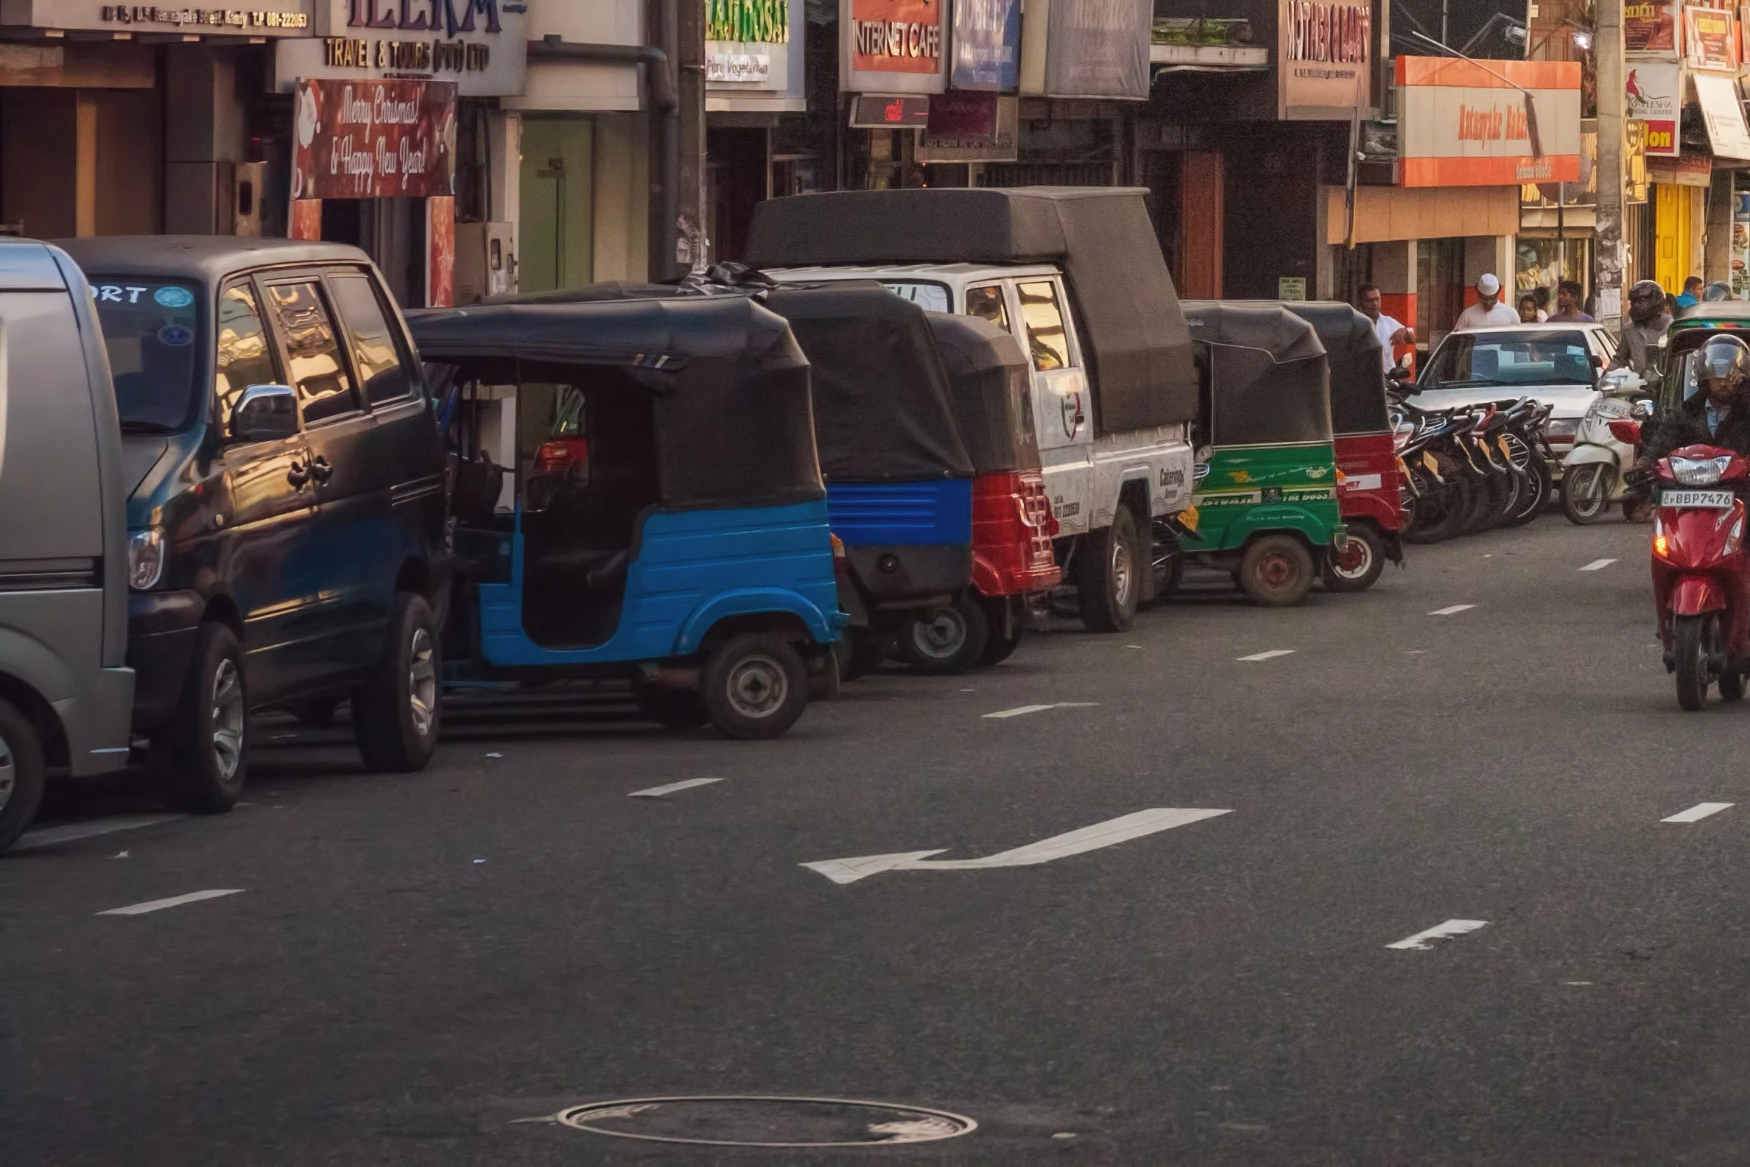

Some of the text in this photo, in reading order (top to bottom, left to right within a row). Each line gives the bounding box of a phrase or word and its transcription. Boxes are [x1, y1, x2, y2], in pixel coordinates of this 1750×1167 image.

[325, 38, 372, 67] TRAVEL
[376, 39, 386, 68] &
[390, 40, 431, 69] TOURS
[852, 18, 940, 58] INTERNET CAFE
[341, 84, 373, 141] Merry
[1644, 123, 1671, 147] lon
[331, 136, 427, 191] & Happy New Year!
